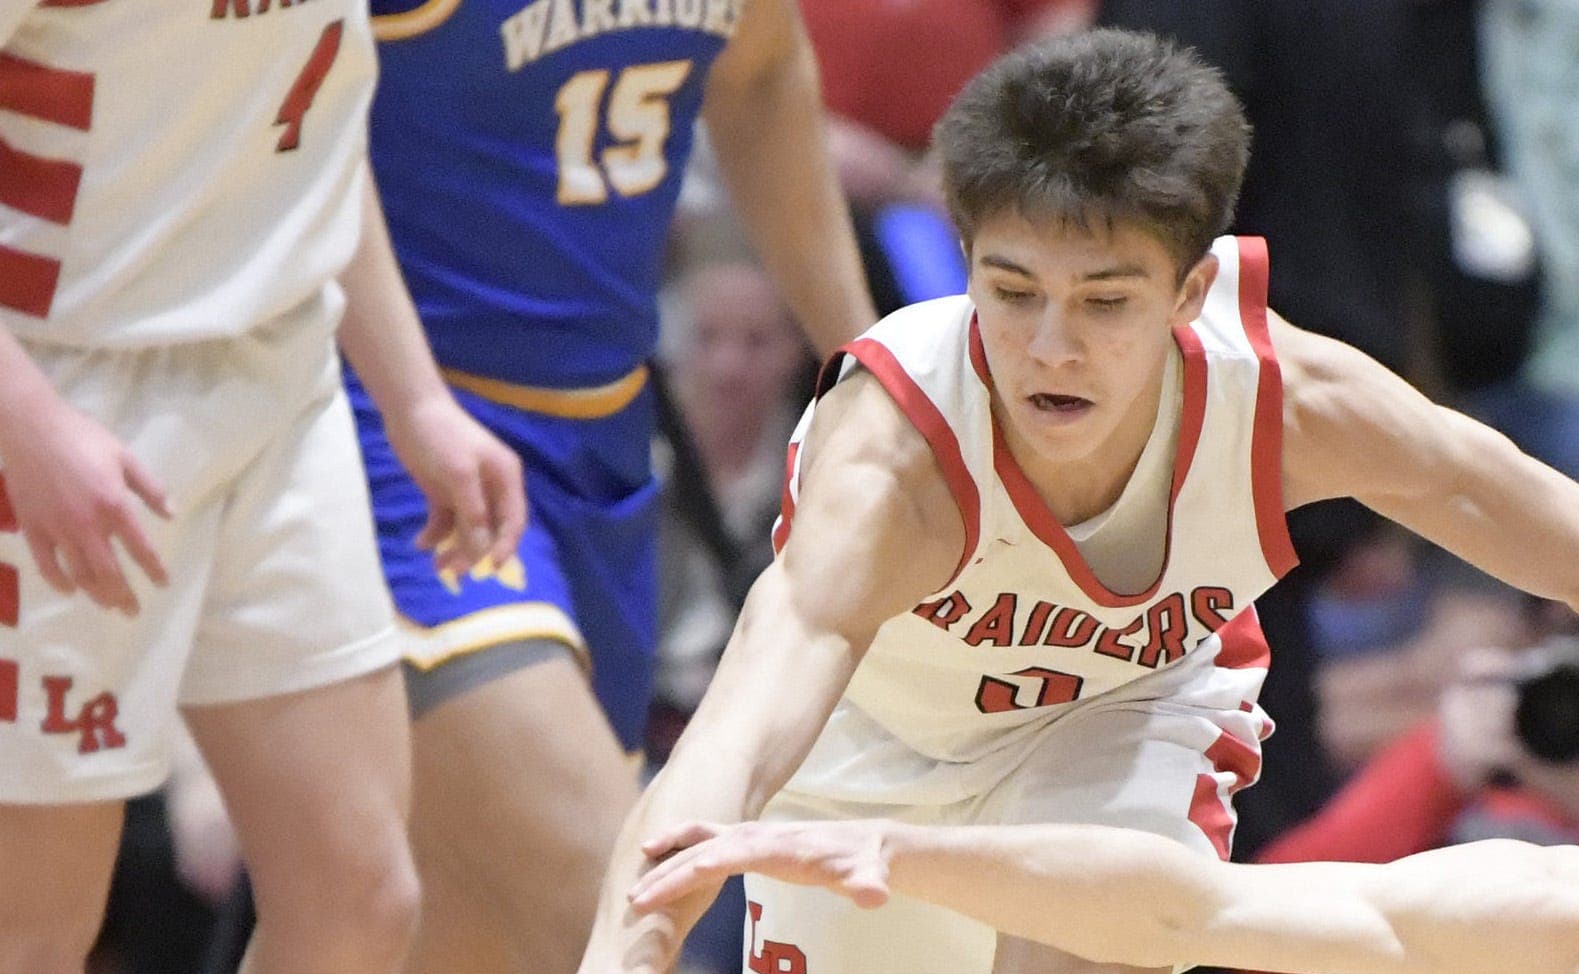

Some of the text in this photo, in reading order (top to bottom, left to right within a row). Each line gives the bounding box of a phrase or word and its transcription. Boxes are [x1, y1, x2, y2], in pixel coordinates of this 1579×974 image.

[501, 0, 740, 71] WARRIOR
[555, 59, 693, 205] 15
[912, 586, 1234, 669] RAIDERS
[41, 675, 126, 755] LR
